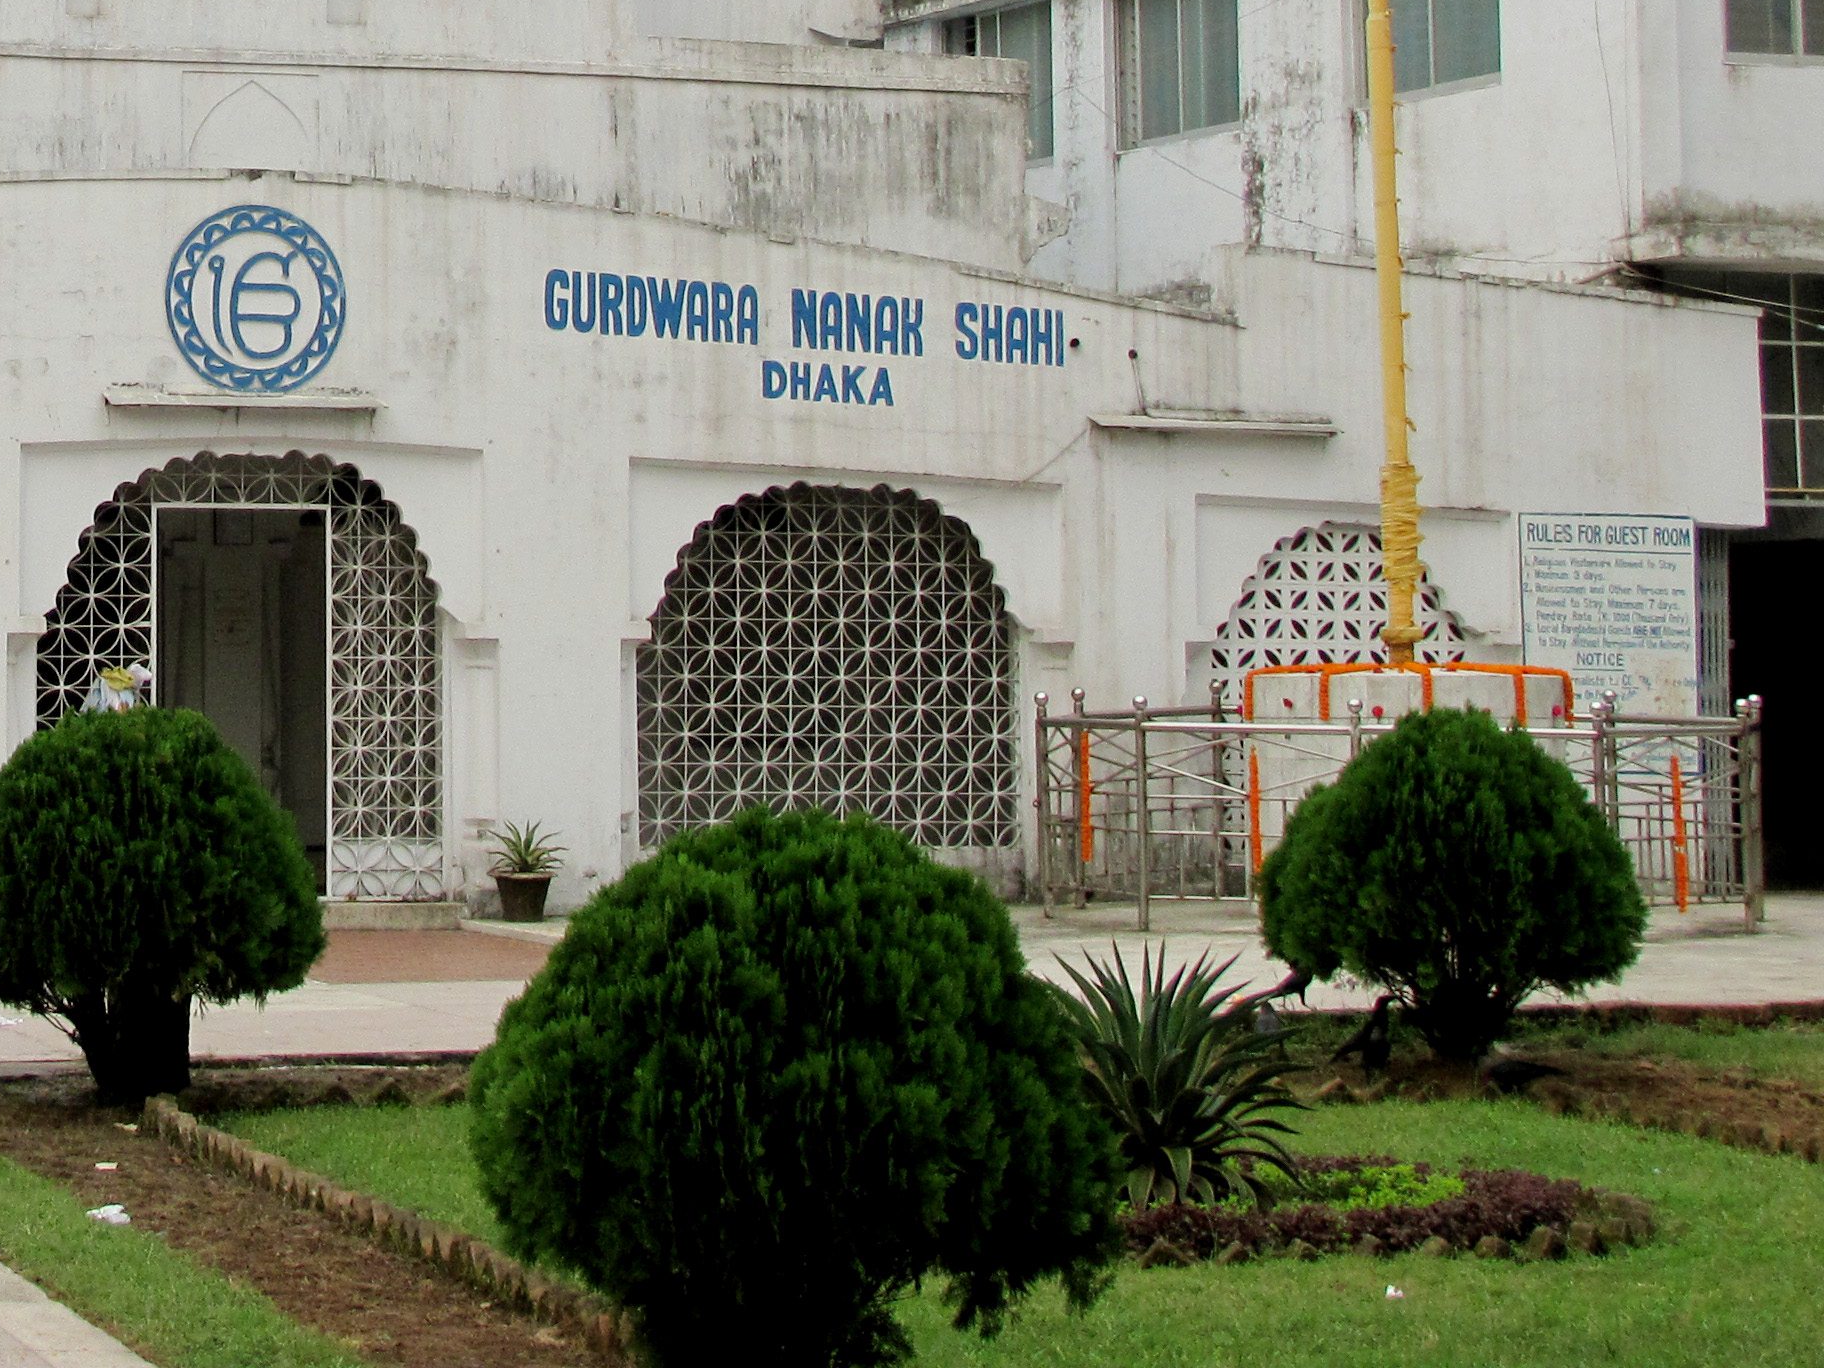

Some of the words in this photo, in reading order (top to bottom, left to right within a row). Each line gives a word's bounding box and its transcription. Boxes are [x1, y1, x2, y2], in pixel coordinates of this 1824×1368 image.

[546, 269, 759, 345] GURDWARA
[792, 289, 924, 356] NANAK
[956, 303, 1065, 366] SHAHI
[763, 361, 894, 406] DHAKA
[1527, 522, 1573, 543] RULES
[1578, 524, 1601, 544] FOR
[1605, 525, 1649, 545] GUEST
[1653, 527, 1691, 547] ROOM
[1658, 559, 1678, 573] Stay
[1576, 651, 1625, 668] NOTICE
